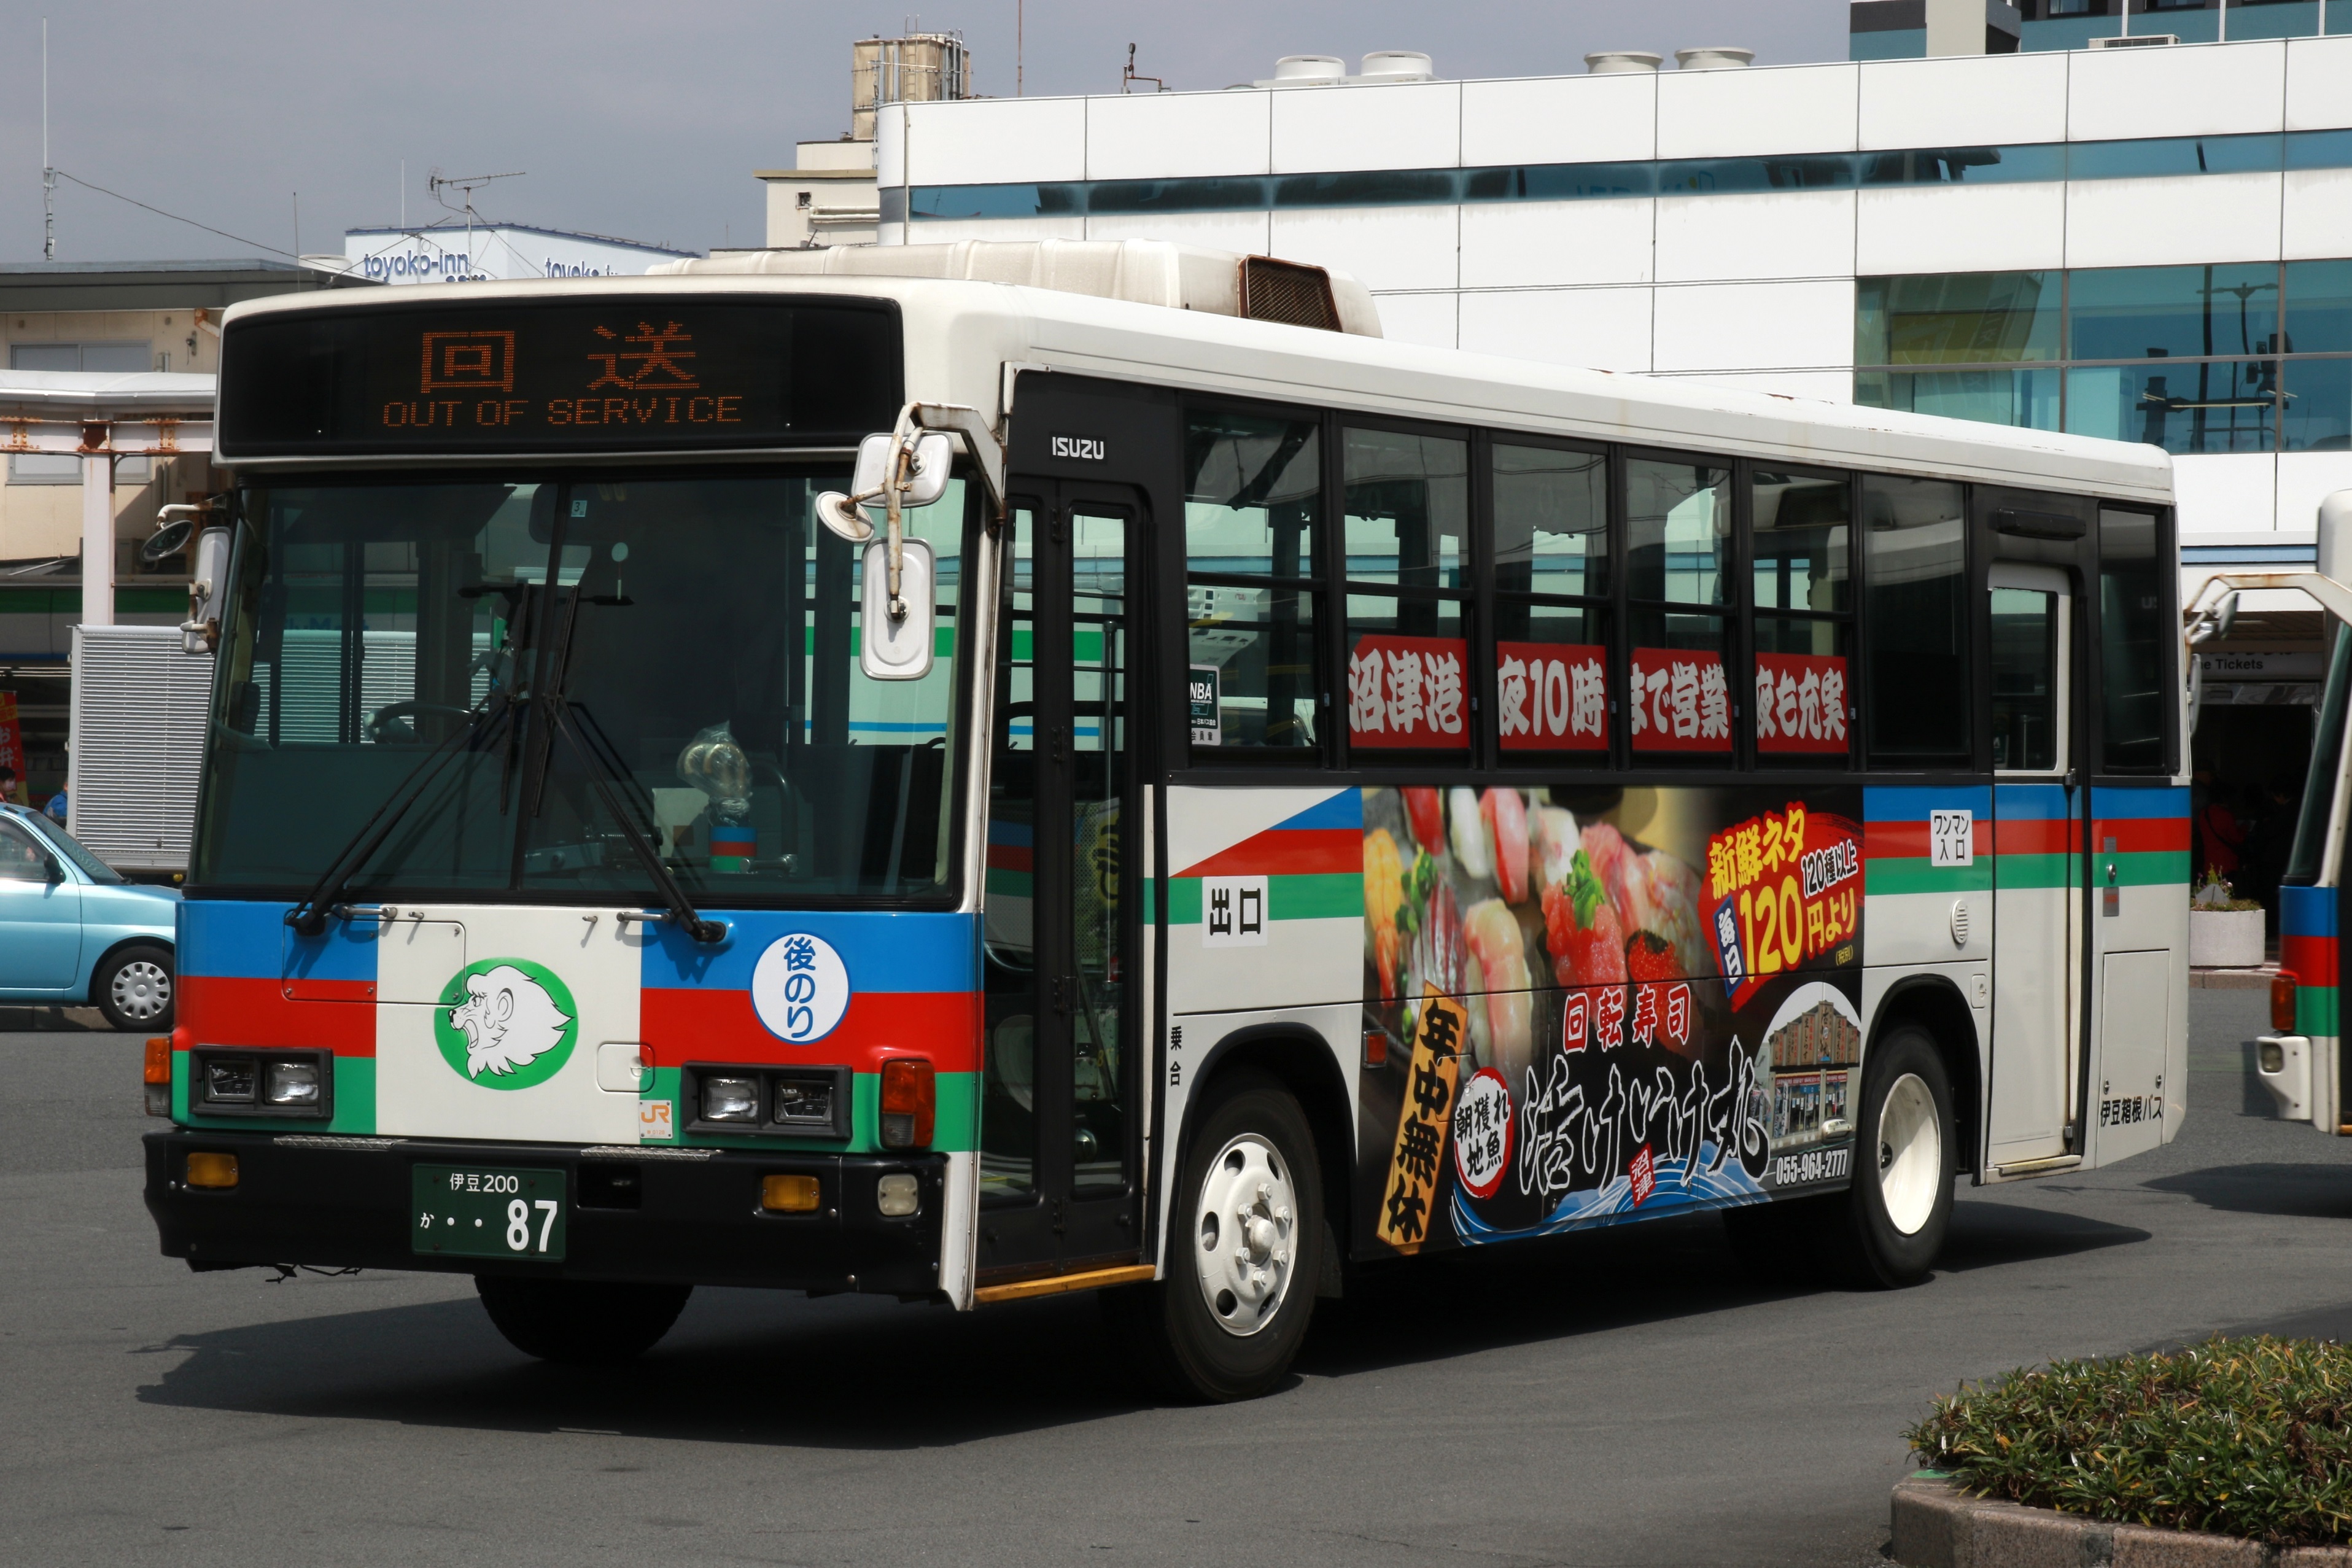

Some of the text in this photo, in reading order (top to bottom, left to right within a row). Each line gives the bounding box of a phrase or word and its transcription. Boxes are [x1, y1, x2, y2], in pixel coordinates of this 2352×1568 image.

[364, 249, 469, 283] toyoko-inn
[382, 395, 742, 427] OUT OF SERVICE
[1052, 436, 1104, 460] ISUZU
[2215, 658, 2264, 670] Tickets
[1190, 681, 1213, 700] NBA
[1348, 648, 1846, 741] 沼津港 夜10時 まで営業 夜も充実
[1933, 814, 1970, 836] ワンマン
[1709, 808, 1805, 899] 新鮮ネタ
[1801, 839, 1858, 898] 120種以上
[1939, 838, 1965, 861] 入口
[1209, 887, 1262, 936] 出口
[1718, 907, 1742, 984] 毎日
[783, 936, 817, 1039] 後のり
[1563, 983, 1691, 1054] 回転寿司
[1170, 1025, 1183, 1087] 乗合
[641, 1104, 670, 1124] JR
[1387, 998, 1461, 1243] 年中無休
[1456, 1090, 1510, 1144] 朝獲れ
[2100, 1096, 2163, 1127] 伊豆箱根バス
[1466, 1131, 1502, 1178] 地魚
[1631, 1149, 1653, 1201] 沼津
[1776, 1149, 1847, 1186] 055-964-2777
[449, 1173, 519, 1193] 伊豆200
[419, 1211, 435, 1229] か
